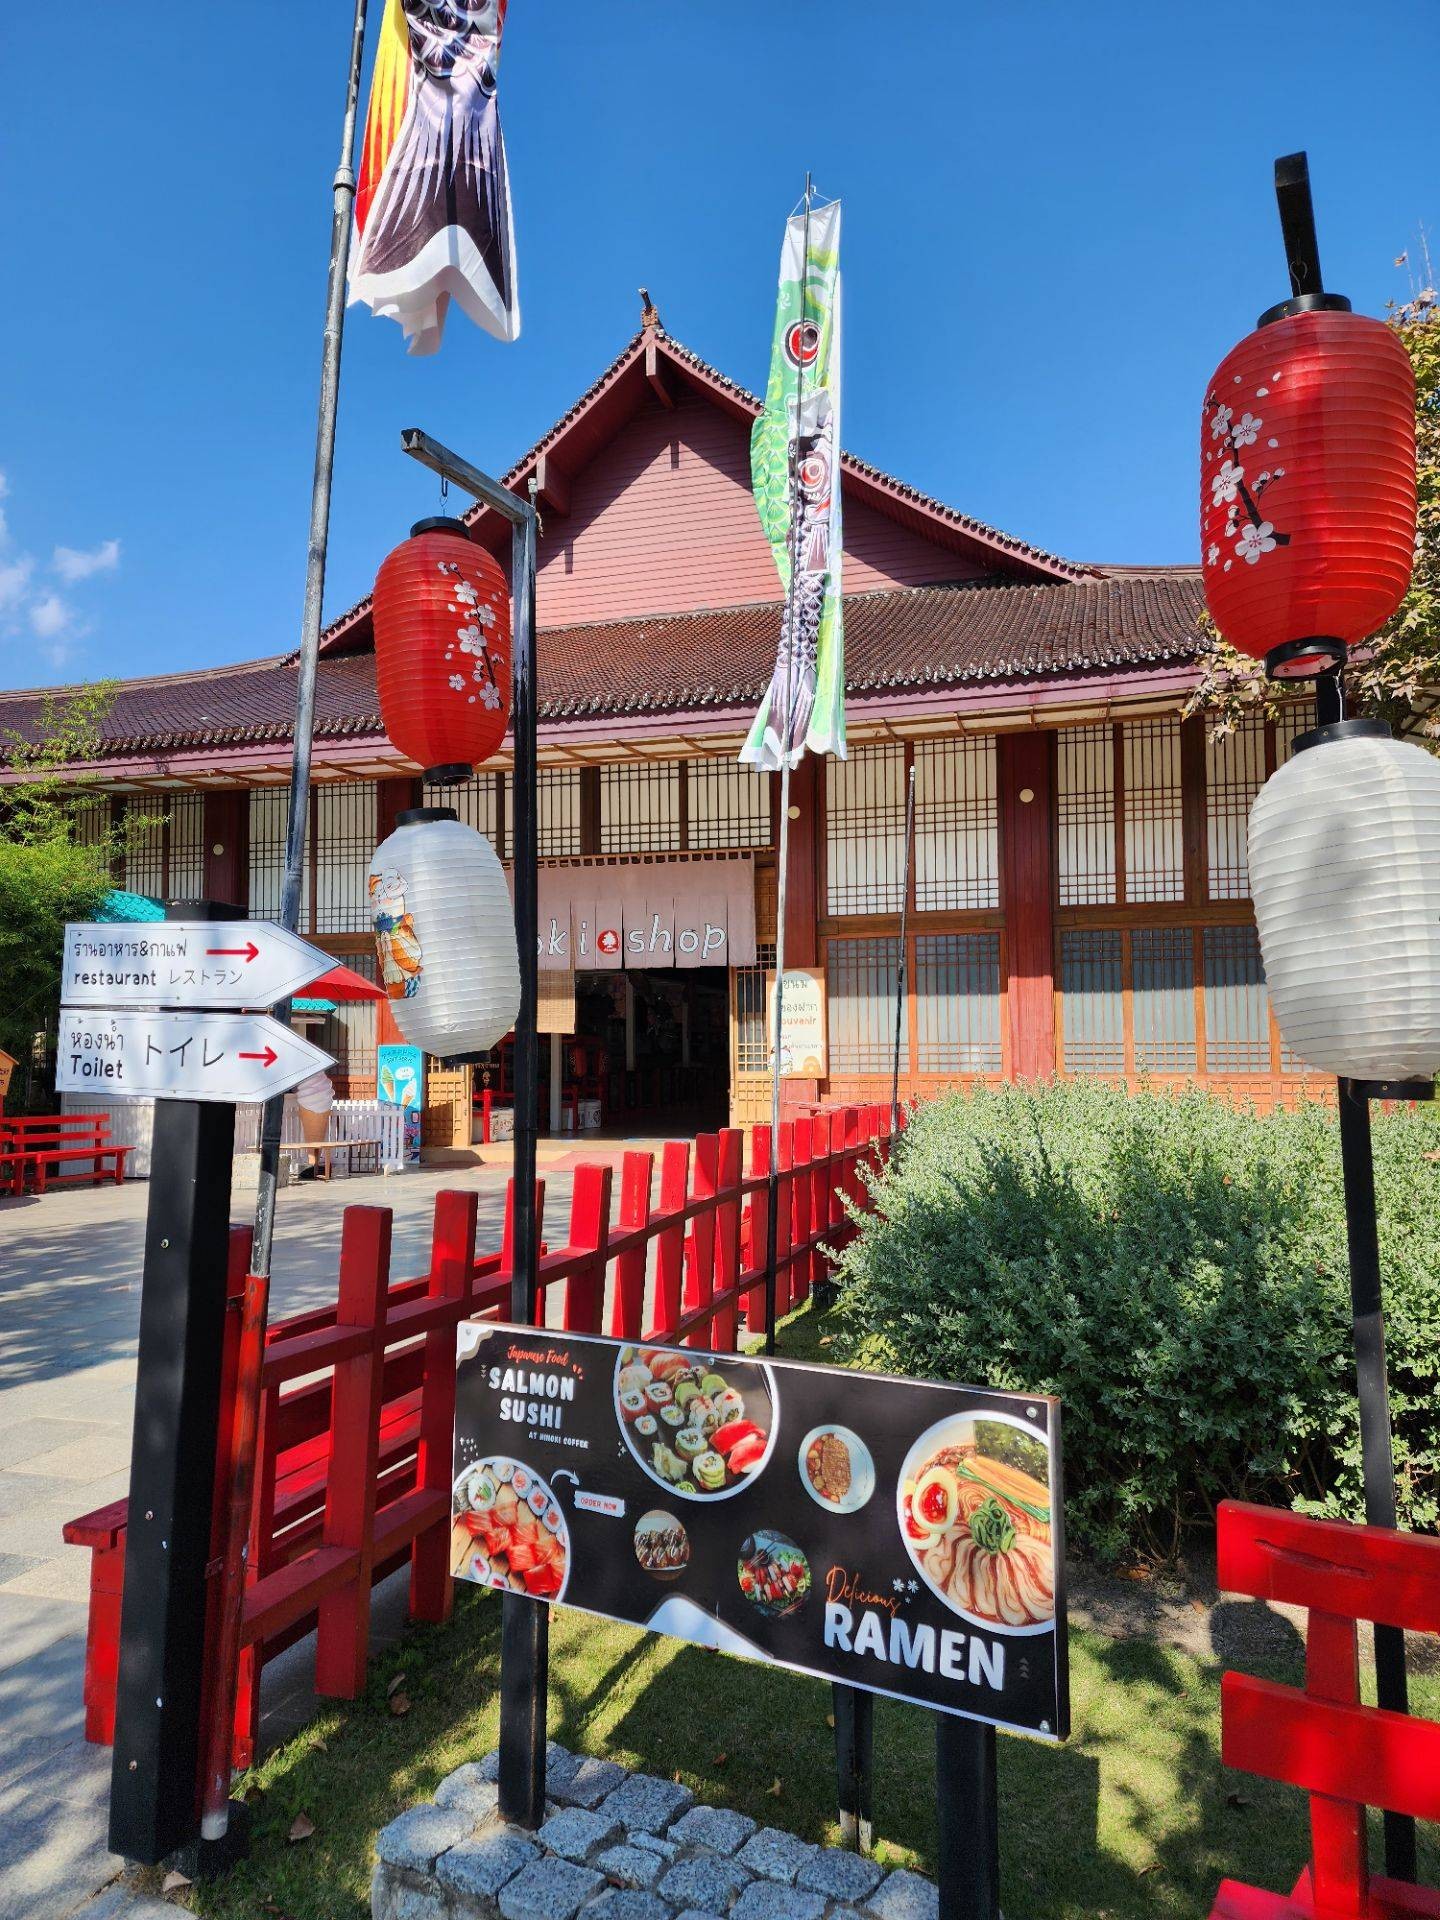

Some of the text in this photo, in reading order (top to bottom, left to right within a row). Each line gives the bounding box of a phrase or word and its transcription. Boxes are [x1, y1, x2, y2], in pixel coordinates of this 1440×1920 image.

[627, 914, 727, 959] shop
[74, 969, 156, 985] restaurant
[169, 969, 243, 985] レストラン
[71, 1019, 124, 1050] ห้องน้ำ
[781, 1017, 817, 1025] ouvenir
[146, 1035, 224, 1067] トイレ
[70, 1054, 123, 1079] Toilet
[545, 1349, 569, 1367] Food
[488, 1366, 575, 1401] SALMON
[500, 1397, 562, 1429] SUSHI
[563, 1436, 589, 1449] COFFEE
[581, 1497, 617, 1511] ORDER NOW
[825, 1564, 901, 1618] Delicious
[823, 1601, 1005, 1691] RAMEN
